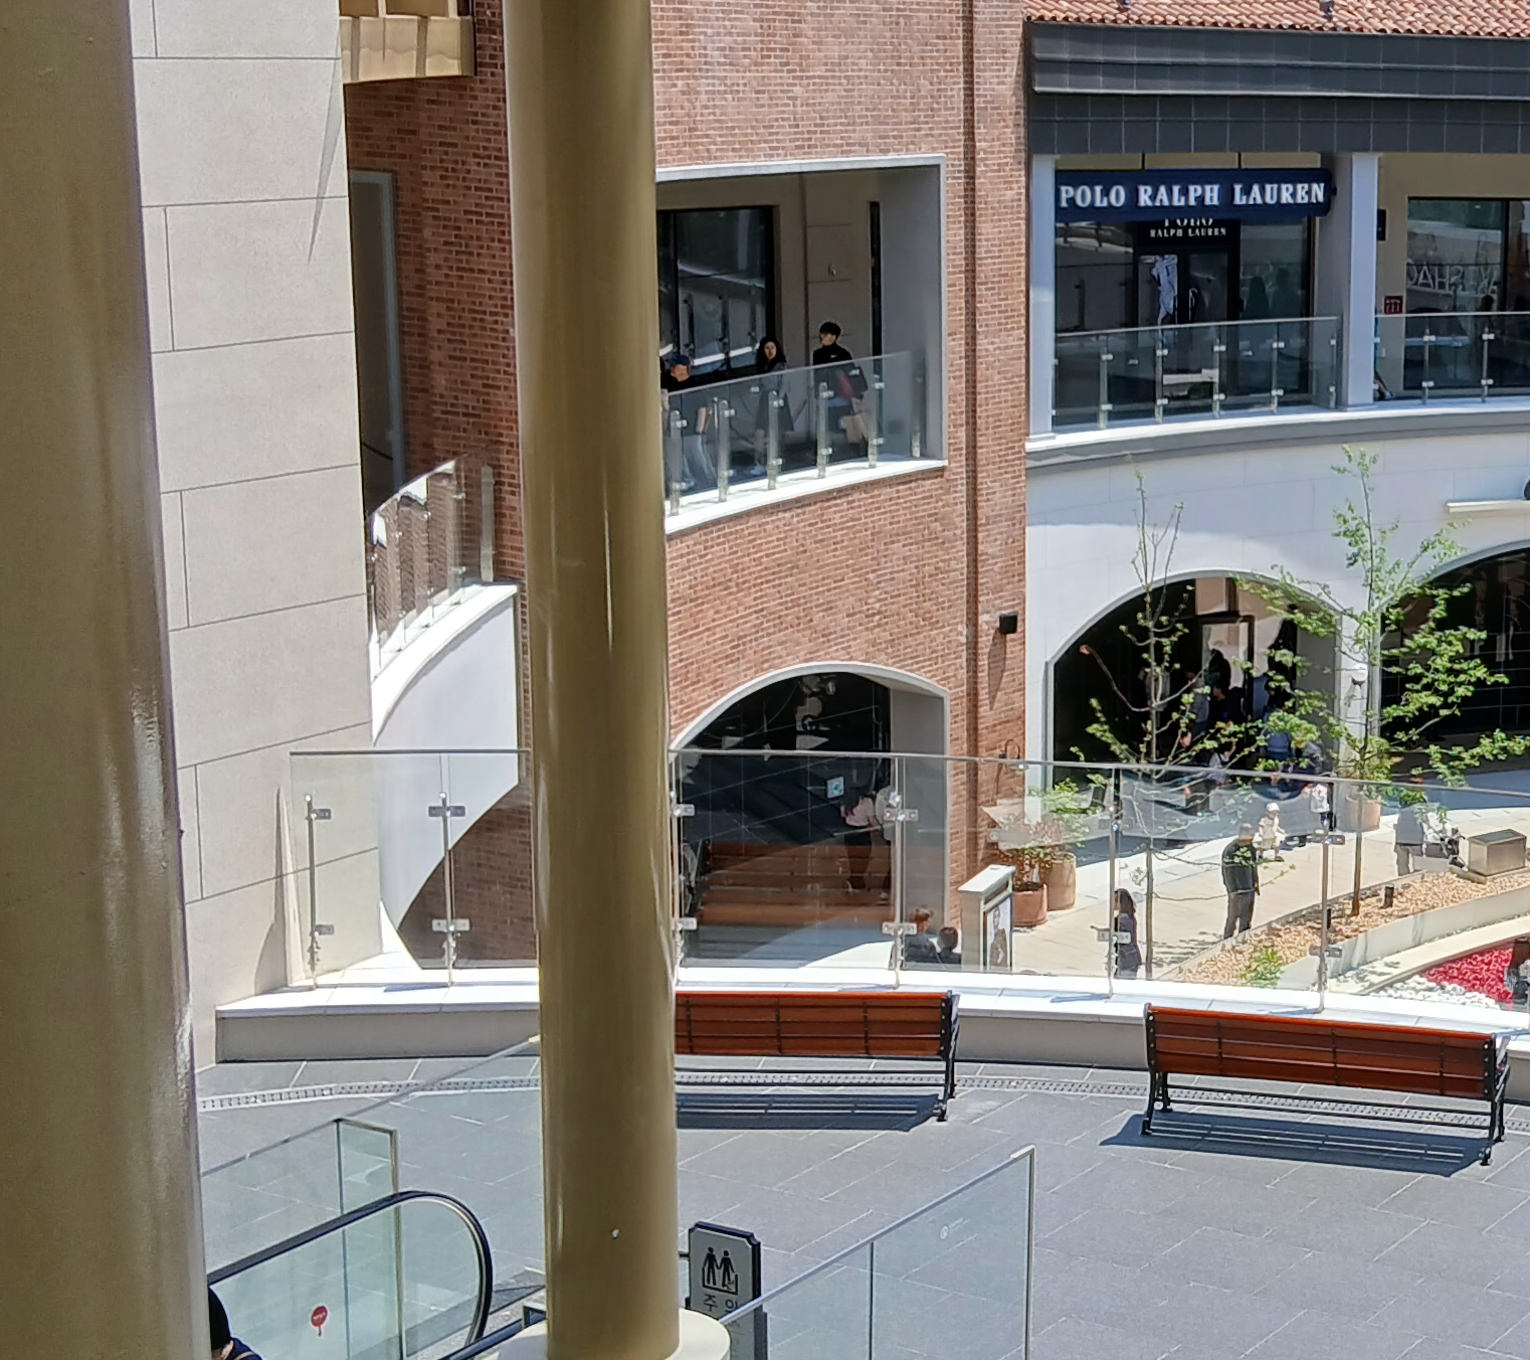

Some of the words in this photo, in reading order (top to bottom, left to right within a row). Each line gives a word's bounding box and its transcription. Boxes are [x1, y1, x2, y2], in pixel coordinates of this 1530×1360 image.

[1059, 185, 1126, 208] POLO
[1137, 184, 1221, 207] RALPH
[1232, 182, 1326, 206] LAUREN
[1149, 228, 1183, 238] RALPH
[1188, 226, 1227, 237] LAUREN
